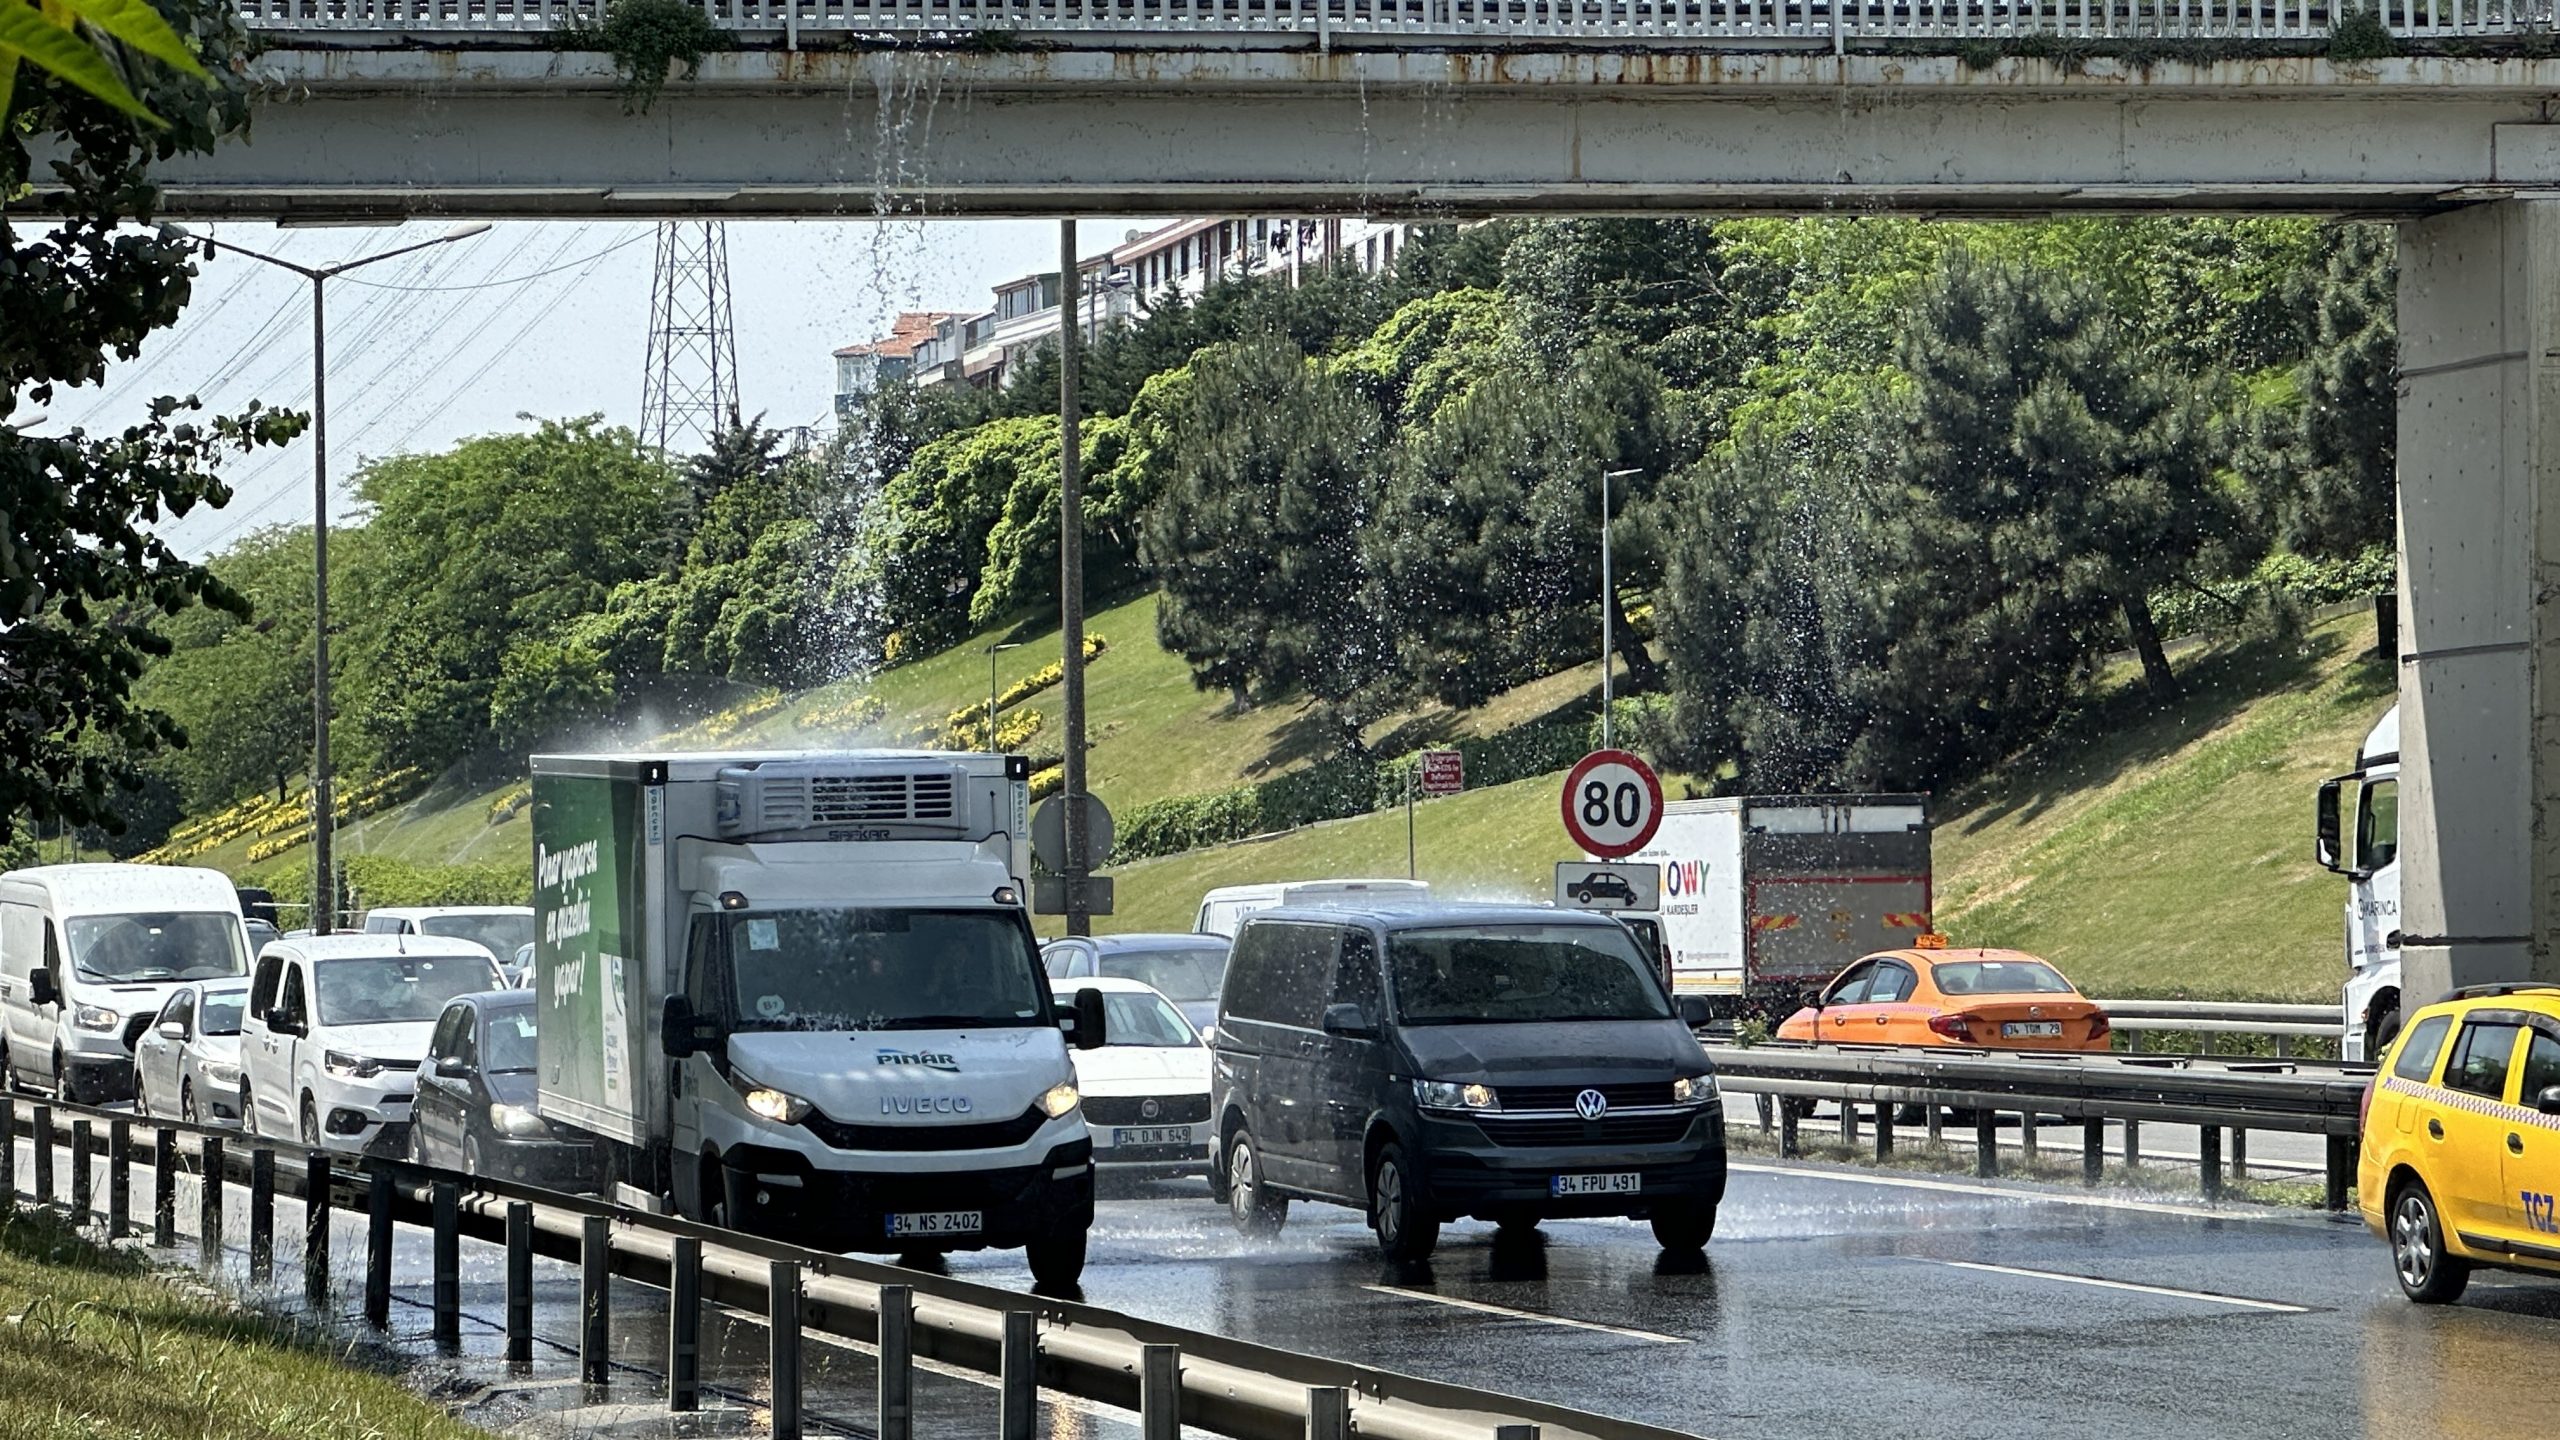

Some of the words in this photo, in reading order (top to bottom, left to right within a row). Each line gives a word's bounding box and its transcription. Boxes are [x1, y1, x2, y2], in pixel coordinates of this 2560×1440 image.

[1583, 781, 1640, 828] 80
[561, 839, 597, 893] yaparsa
[1660, 860, 1710, 897] OWY
[546, 910, 556, 944] en
[554, 951, 585, 1009] yapar!
[876, 1051, 957, 1066] PINAR
[881, 1096, 973, 1115] IVECO
[1121, 1131, 1135, 1144] 34
[1560, 1176, 1576, 1192] 34
[1582, 1175, 1606, 1191] FPU
[1613, 1174, 1636, 1190] 491
[894, 1215, 912, 1231] 34
[920, 1214, 937, 1230] NS
[944, 1213, 979, 1230] 2402
[2521, 1191, 2558, 1233] TCZ
